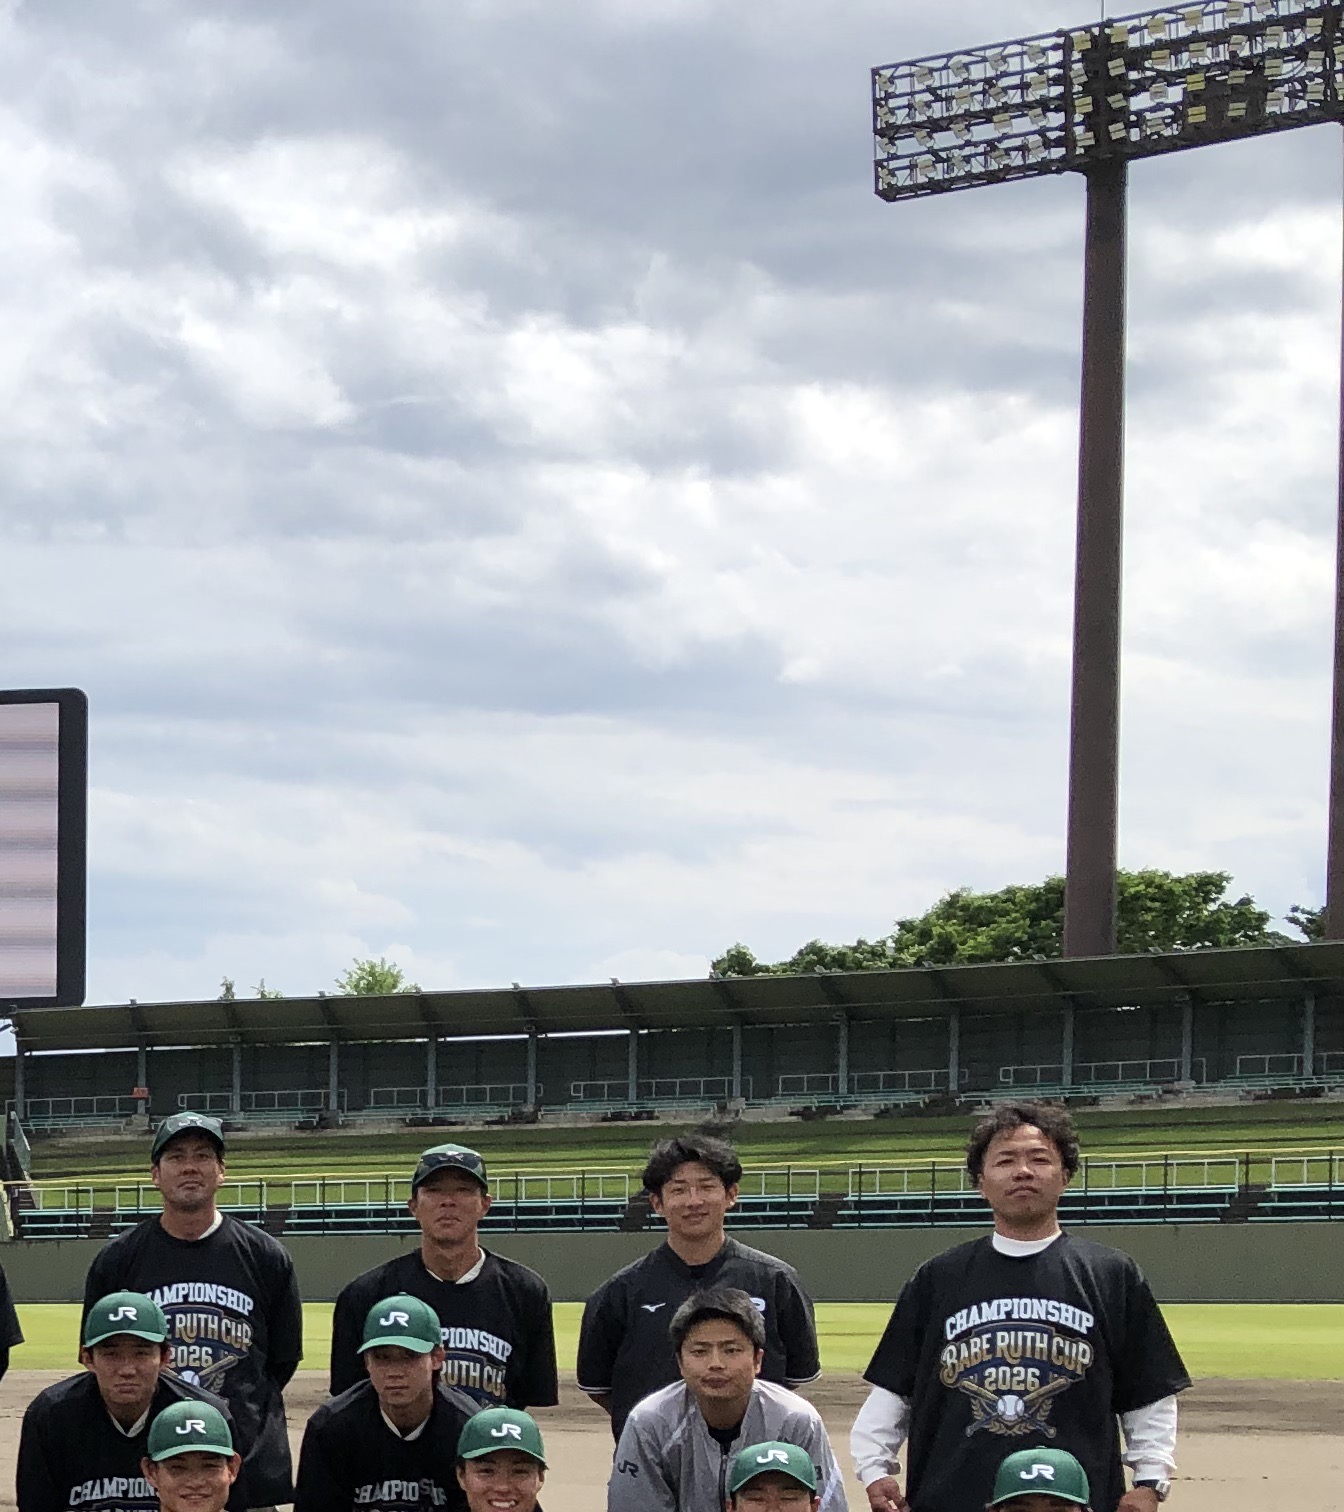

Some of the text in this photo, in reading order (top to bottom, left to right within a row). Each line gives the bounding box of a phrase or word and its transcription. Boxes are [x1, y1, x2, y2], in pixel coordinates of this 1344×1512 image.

[108, 1306, 137, 1321] JR
[380, 1311, 410, 1327] JR
[945, 1298, 1094, 1340] CHAMPIONSHIP
[175, 1313, 218, 1344] RUTH
[441, 1327, 512, 1363] PIONSHIP
[940, 1331, 1091, 1384] BABE RUTH CUP
[983, 1366, 1041, 1391] 2026
[176, 1419, 207, 1434] JR
[491, 1423, 522, 1440] JR
[756, 1449, 790, 1464] JR
[618, 1460, 639, 1479] JR
[1019, 1463, 1055, 1481] JR
[69, 1477, 159, 1506] CHAMPION
